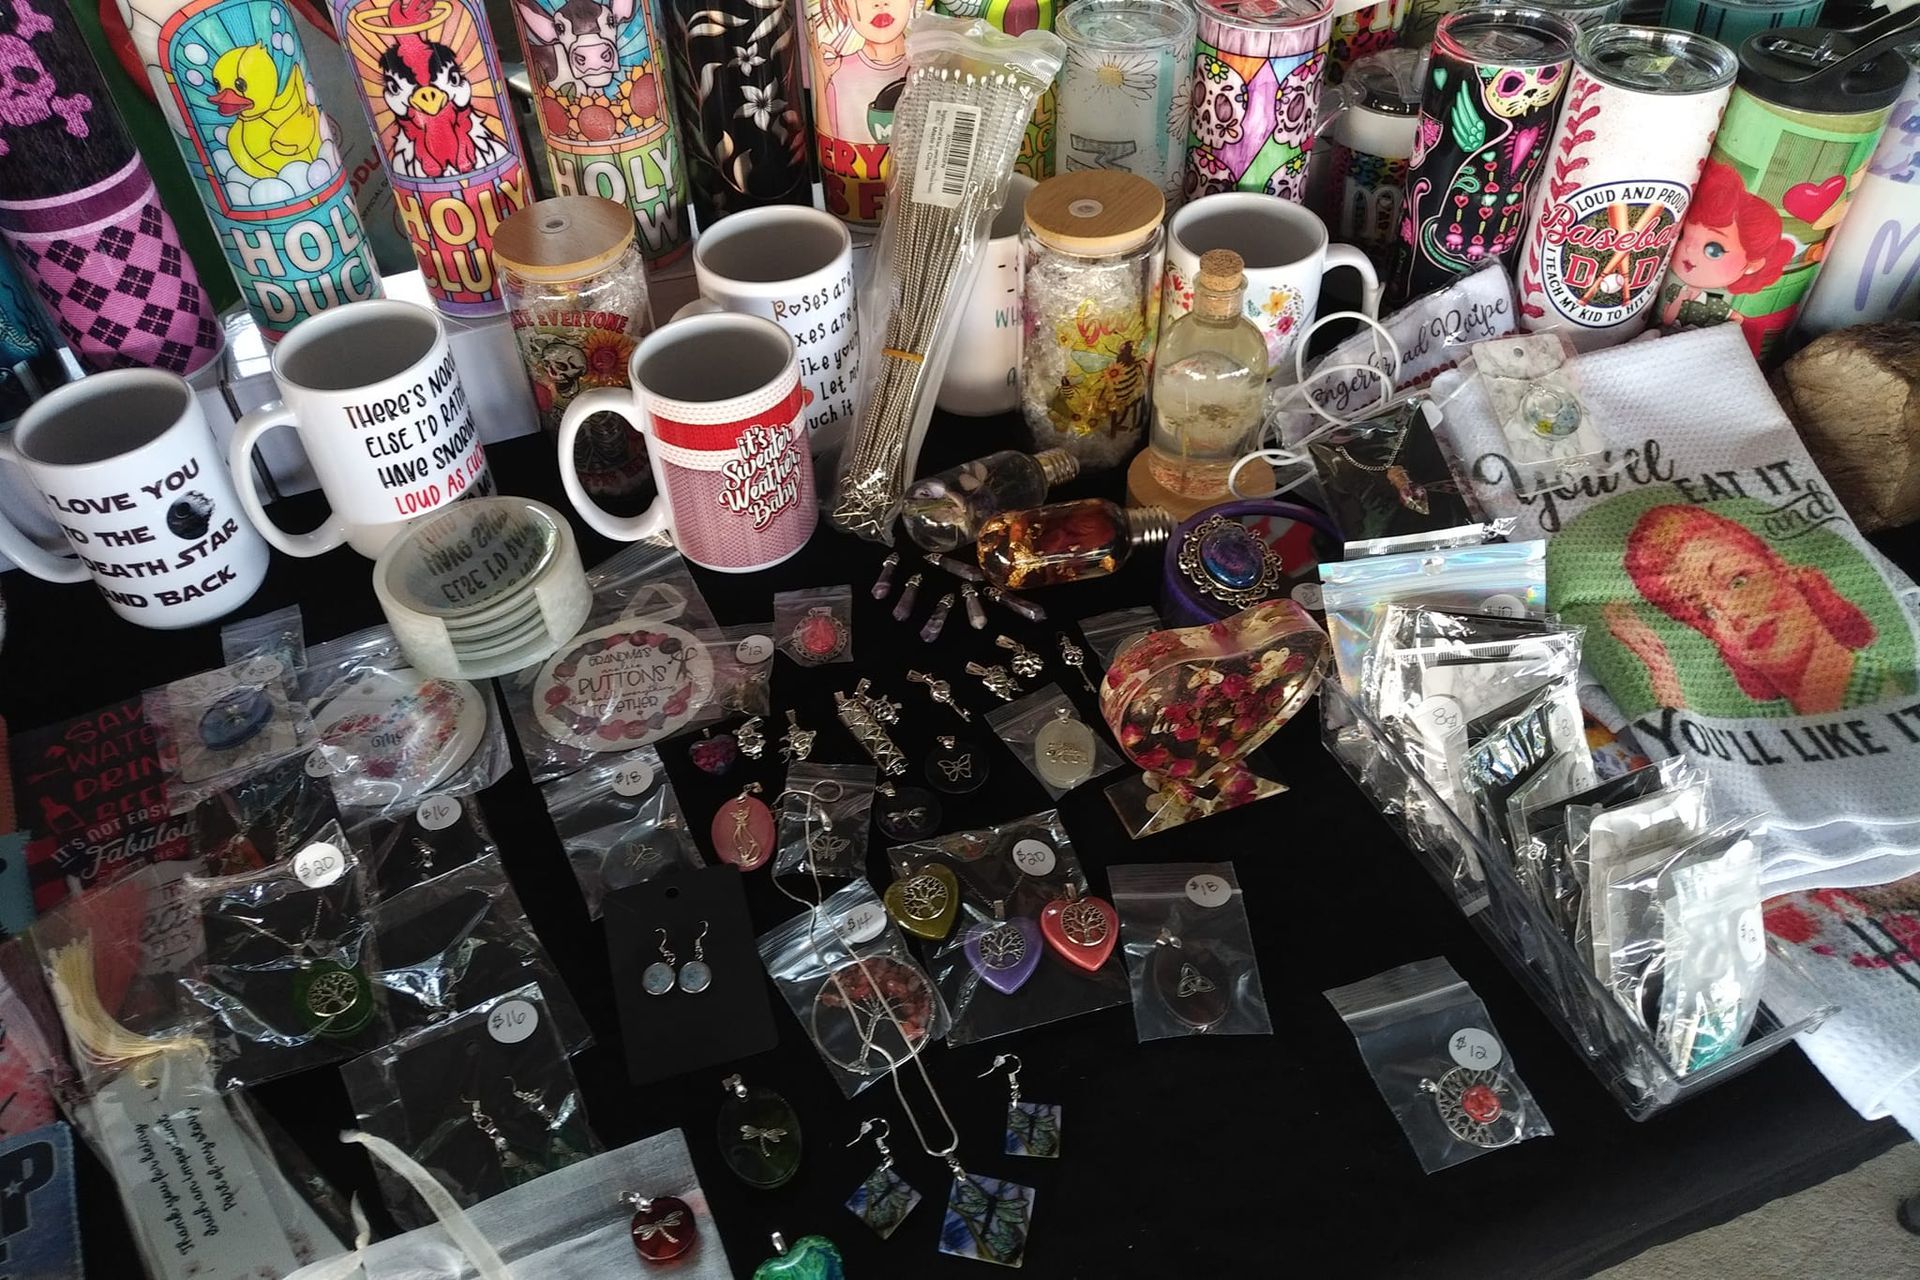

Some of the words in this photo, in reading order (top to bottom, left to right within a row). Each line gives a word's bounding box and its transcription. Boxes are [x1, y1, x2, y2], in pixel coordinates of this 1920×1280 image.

[549, 139, 675, 204] HOLY
[393, 168, 526, 246] HOLY
[1575, 190, 1615, 212] LOUD
[1622, 187, 1656, 201] AND
[1656, 187, 1687, 214] PROUD
[1541, 203, 1678, 251] Baseba
[411, 241, 502, 293] CLU
[1545, 256, 1565, 297] TEACH
[1559, 298, 1579, 314] MY
[1578, 308, 1603, 323] KID
[1606, 310, 1622, 322] TO
[1626, 296, 1645, 315] HIT
[537, 309, 629, 335] EVERYONE
[795, 322, 827, 348] xes
[801, 354, 830, 377] ike
[820, 376, 847, 401] Let
[809, 403, 839, 430] uch
[842, 399, 854, 417] it
[365, 428, 414, 459] ELSE
[414, 414, 439, 444] I'D
[721, 424, 794, 491] Sweater
[49, 493, 137, 515] LOVE
[141, 457, 200, 501] YOU
[395, 484, 441, 516] LOUD
[447, 468, 467, 498] AS
[718, 446, 801, 512] Weather
[1473, 438, 1674, 532] You'll
[1671, 471, 1750, 503] EAT
[1755, 460, 1803, 496] IT
[1763, 478, 1835, 539] and
[80, 554, 170, 580] DEATH
[175, 517, 239, 570] STAR
[93, 525, 156, 548] THE
[99, 584, 149, 609] AND
[153, 564, 237, 607] BACK
[578, 665, 667, 695] BUTTONS
[64, 703, 145, 744] SAV
[1634, 706, 1784, 766] YOU'LL
[1781, 720, 1891, 763] LIKE
[66, 724, 158, 773] WATE
[73, 755, 161, 803] DRIN
[421, 805, 450, 821] $16
[50, 837, 85, 863] IT'S
[81, 818, 197, 880] Fabulou
[299, 855, 335, 878] $20
[1015, 849, 1047, 866] $20
[492, 1009, 527, 1030] $16
[134, 1123, 155, 1164] being
[202, 1141, 216, 1166] my
[150, 1159, 169, 1184] for
[189, 1180, 203, 1201] an
[206, 1164, 225, 1181] of
[158, 1181, 181, 1209] you
[214, 1180, 237, 1212] Part
[164, 1207, 195, 1256] Thank
